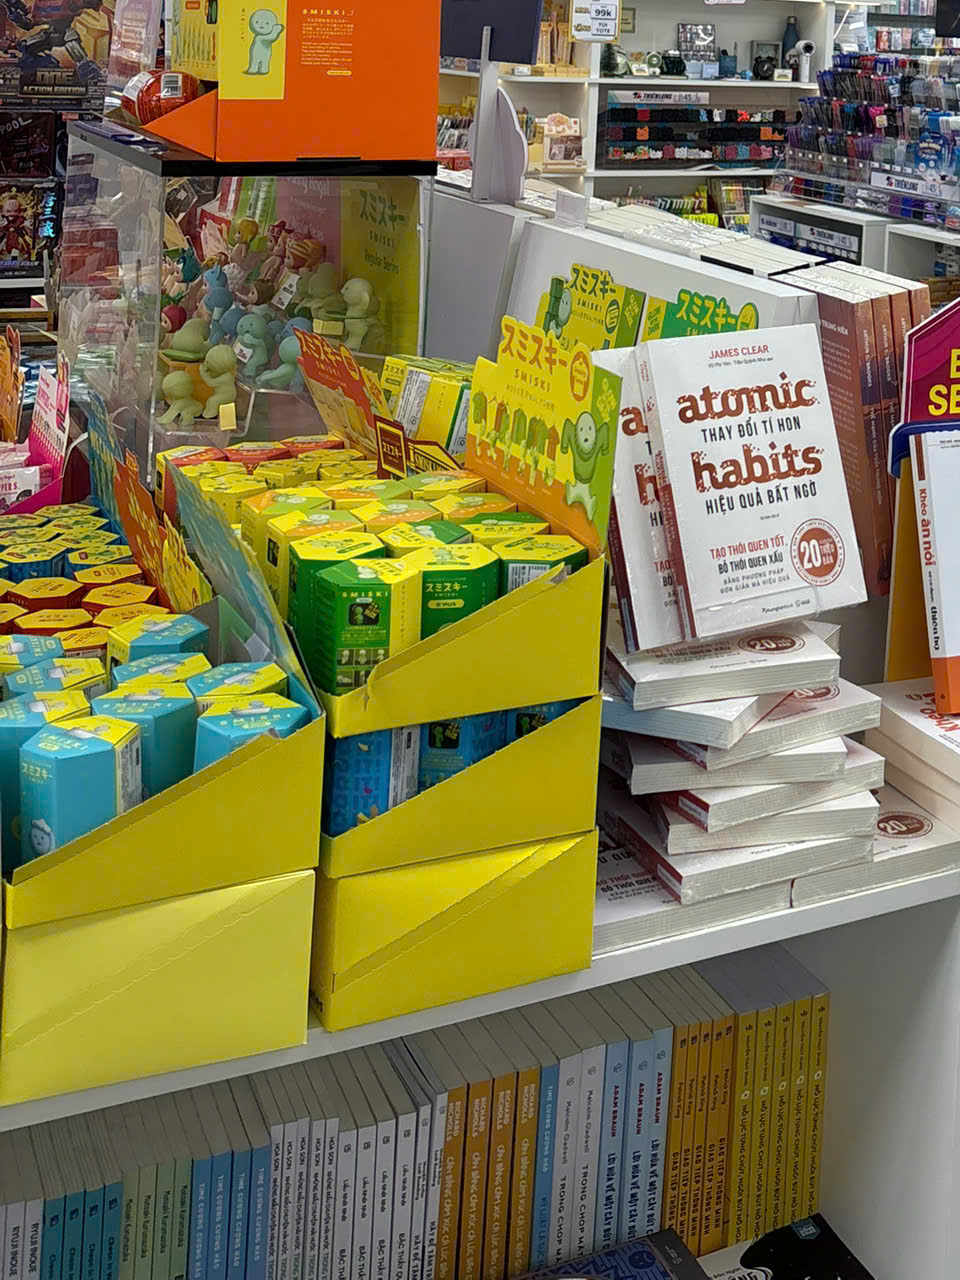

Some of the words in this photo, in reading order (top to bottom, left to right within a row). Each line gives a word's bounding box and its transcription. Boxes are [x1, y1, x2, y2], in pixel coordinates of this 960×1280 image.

[594, 8, 612, 18] 99k
[23, 85, 52, 95] ACTION
[54, 84, 86, 95] EDITION
[570, 265, 616, 300] スミスキー
[676, 290, 738, 326] スミスキー
[502, 324, 568, 376] スミスキー
[709, 346, 740, 360] JAMES
[741, 343, 769, 358] CLEAR
[513, 368, 551, 393] SMISKI
[676, 372, 820, 424] atomic
[701, 425, 733, 443] THAY
[737, 418, 759, 439] ĐỔI
[777, 415, 801, 431] HON
[691, 441, 825, 494] habits
[705, 495, 736, 516] HIỆU
[739, 486, 764, 510] QUẢ
[766, 483, 791, 505] BẤT
[794, 480, 819, 500] NGỜ
[710, 548, 727, 561] TẠO
[727, 542, 747, 557] THÓI
[747, 539, 769, 554] QUEN
[718, 561, 730, 575] BỎ
[730, 557, 747, 571] THÓI
[748, 554, 768, 569] QUEN
[769, 550, 785, 564] XẤU
[801, 538, 822, 570] 20
[342, 590, 389, 599] SMISKI
[425, 582, 468, 593] スミスキー
[751, 637, 777, 650] 20
[878, 819, 906, 835] 20
[612, 1085, 620, 1108] ADAM
[636, 1083, 644, 1106] ADAM
[655, 1072, 663, 1095] ADAM
[496, 1091, 505, 1130] NICHOLLS
[503, 1090, 511, 1125] RICHARD
[520, 1085, 529, 1124] NICHOLLS
[528, 1083, 536, 1119] RICHARD
[654, 1096, 662, 1124] BRAUN
[611, 1109, 619, 1137] BRAUN
[635, 1107, 643, 1135] BRAUN
[558, 1176, 567, 1213] TRONG
[580, 1164, 589, 1201] TRONG
[9, 1226, 20, 1249] RYUJI
[29, 1223, 40, 1246] RYUJI
[8, 1251, 19, 1277] INOUE
[28, 1248, 38, 1274] INOUE
